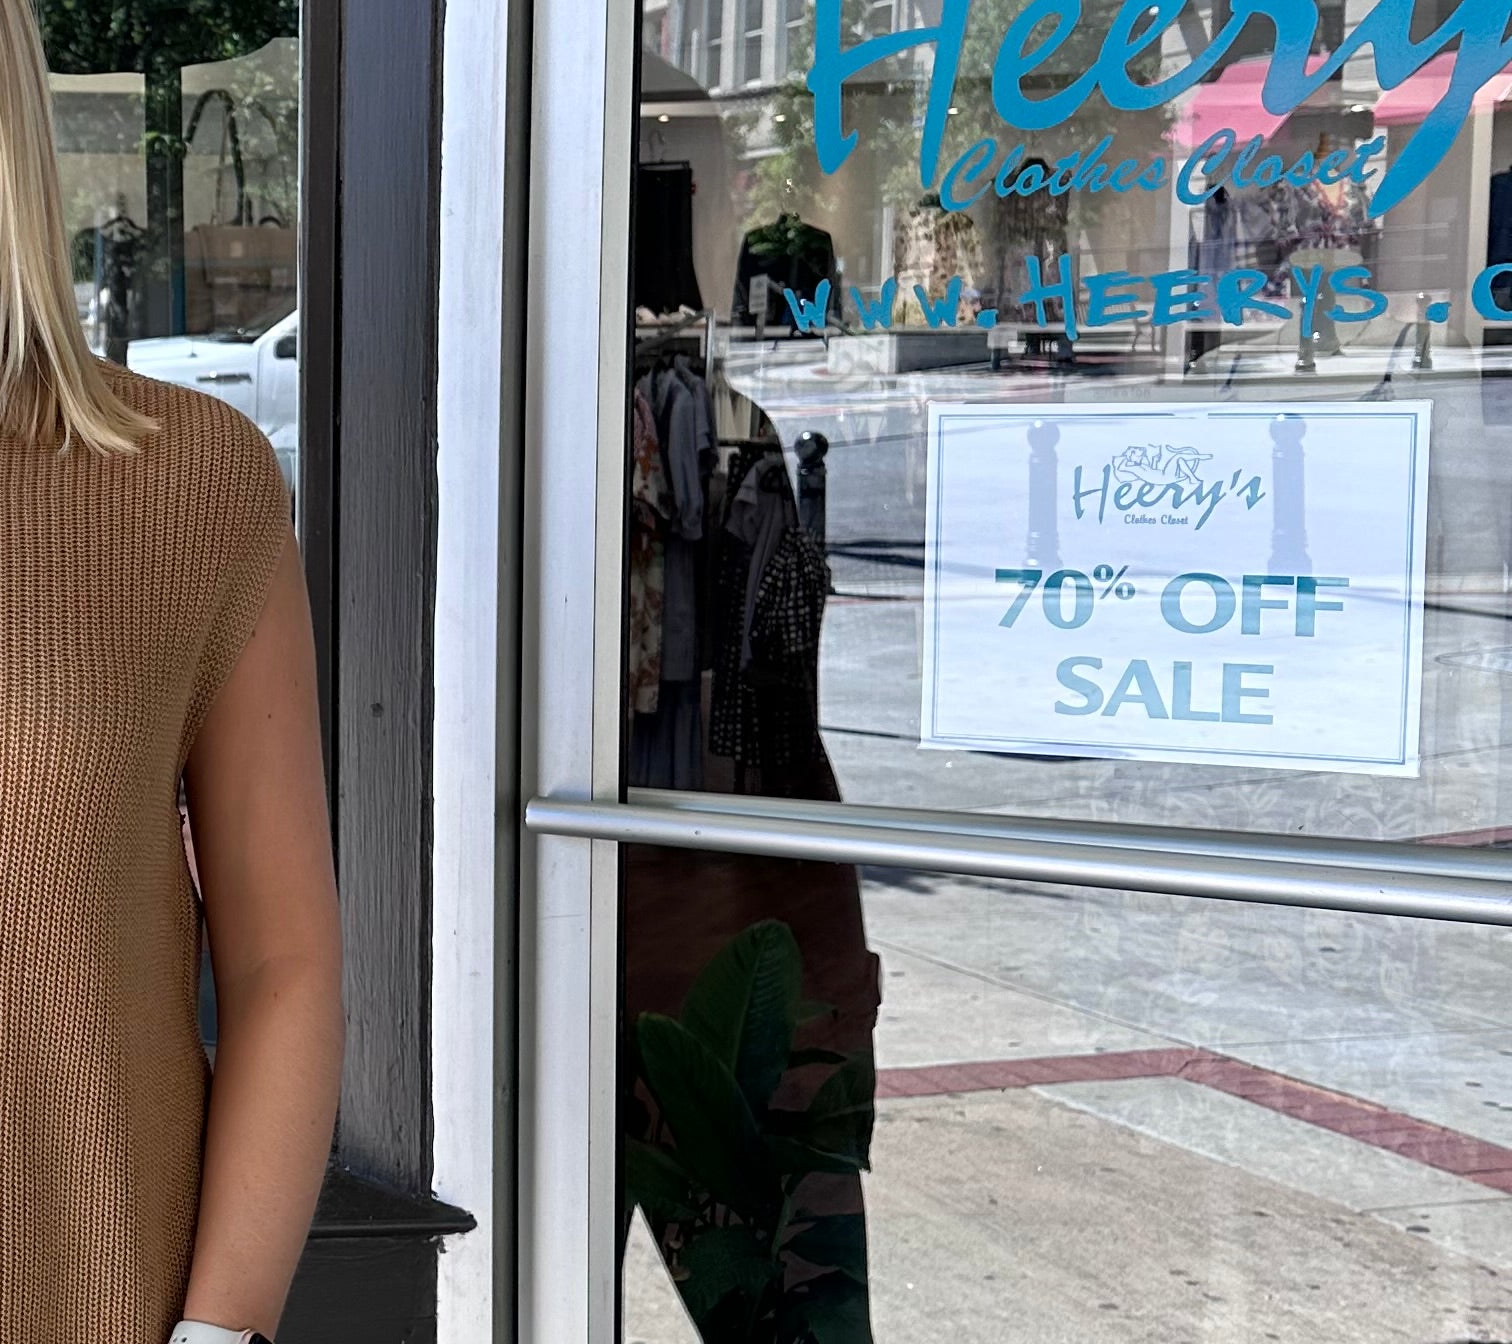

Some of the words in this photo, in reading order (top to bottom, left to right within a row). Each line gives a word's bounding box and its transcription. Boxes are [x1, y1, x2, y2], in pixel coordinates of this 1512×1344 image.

[939, 134, 1168, 212] Clothes
[1176, 128, 1386, 205] Closet
[1072, 464, 1266, 530] Heery's
[995, 564, 1135, 629] 70%
[1160, 572, 1350, 637] OFF
[1054, 656, 1274, 725] SALE
